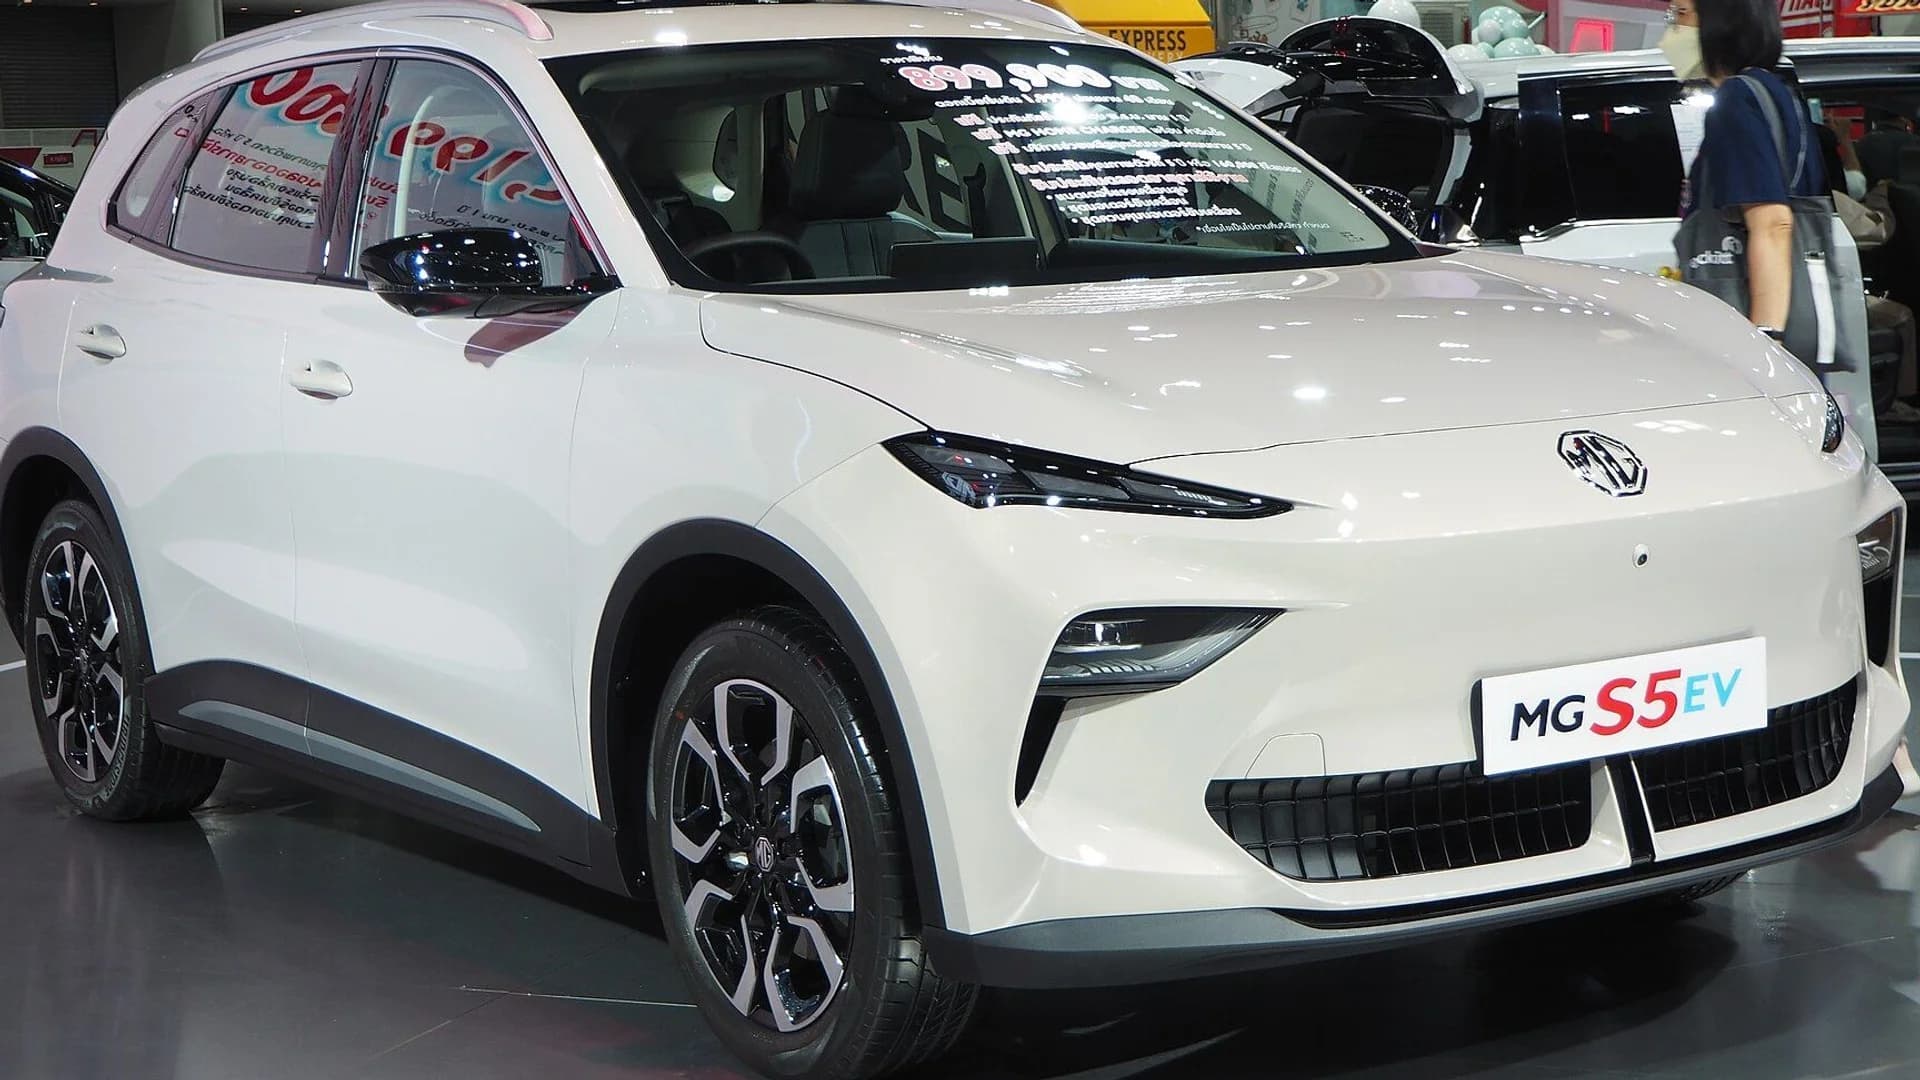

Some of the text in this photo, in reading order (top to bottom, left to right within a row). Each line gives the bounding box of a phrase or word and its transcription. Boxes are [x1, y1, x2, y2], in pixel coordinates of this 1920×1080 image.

[898, 63, 1170, 93] 899,900 บาท
[953, 113, 985, 126] ฟรี
[970, 127, 1003, 140] ฟรี
[1003, 129, 1032, 138] MG
[1030, 127, 1081, 137] HOME
[1080, 125, 1152, 135] CHARGER
[988, 141, 1021, 154] ฟรี
